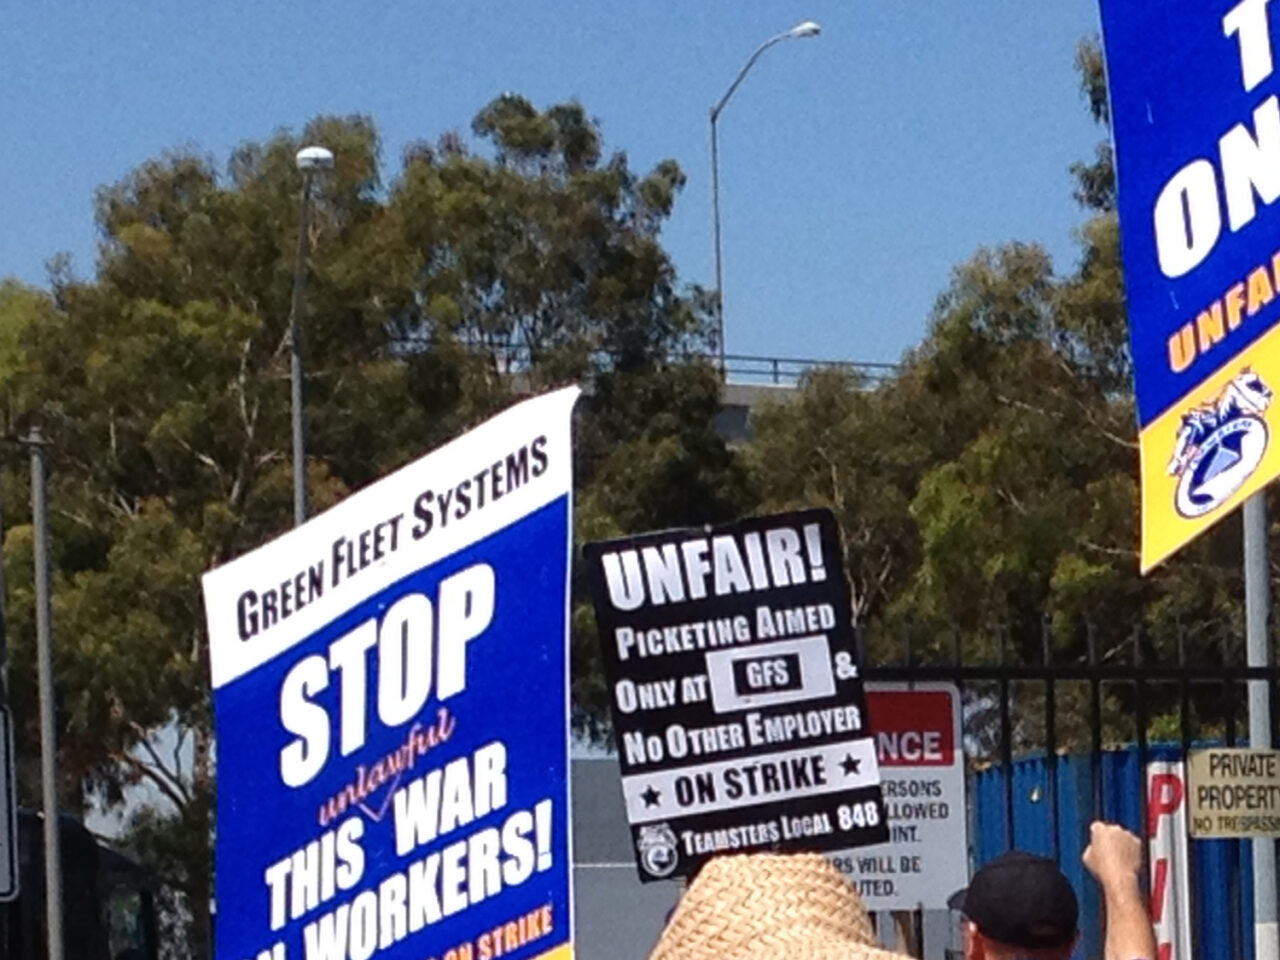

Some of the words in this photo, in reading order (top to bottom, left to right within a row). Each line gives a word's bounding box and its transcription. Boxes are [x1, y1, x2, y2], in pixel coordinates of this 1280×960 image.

[237, 560, 324, 642] GREEN
[332, 513, 404, 588] FLEET
[412, 435, 549, 541] SYSTEMS
[602, 523, 827, 611] UNFAIR!
[615, 616, 750, 661] PICKETING
[756, 604, 835, 640] AIMED
[279, 562, 496, 788] STOP
[615, 678, 676, 714] ONLY
[681, 674, 708, 703] AT
[746, 660, 790, 688] GFS
[834, 651, 858, 680] &
[622, 731, 664, 766] NO
[665, 721, 746, 759] OTHER
[746, 705, 862, 746] EMPLOYER
[317, 706, 456, 826] unlawful
[674, 771, 716, 808] ON
[724, 755, 827, 801] STRIKE
[882, 780, 943, 798] ERSONS
[1209, 752, 1277, 778] PRIVATE
[265, 816, 364, 932] THIS
[394, 740, 507, 857] WAR
[681, 823, 781, 856] TEAMSTERS
[781, 813, 834, 841] LOCAL
[837, 801, 879, 831] 848
[886, 803, 950, 820] LLOWED
[1193, 814, 1213, 833] NO
[858, 857, 897, 874] WILL
[900, 856, 921, 874] BE
